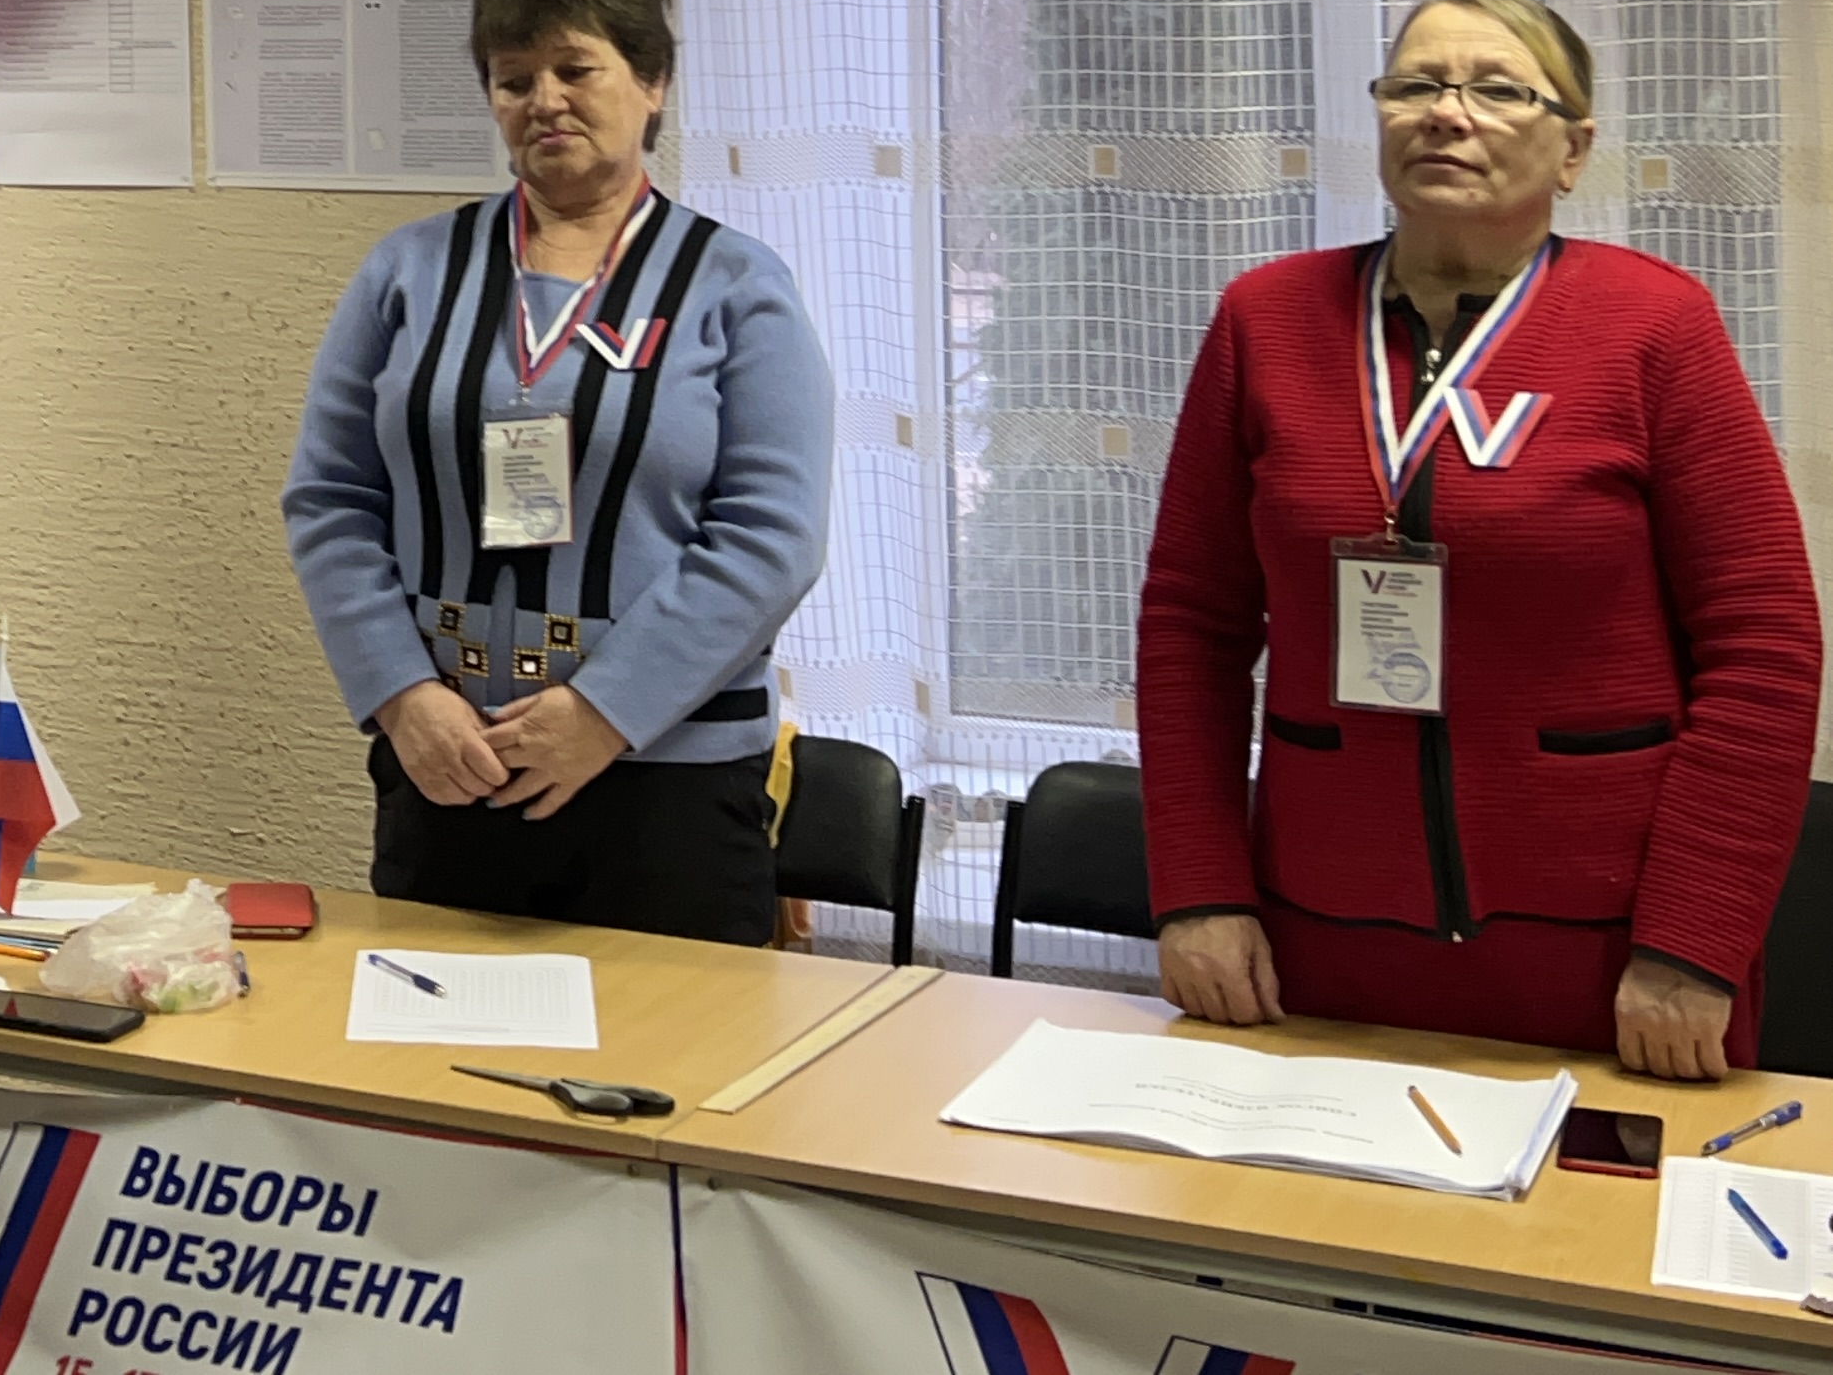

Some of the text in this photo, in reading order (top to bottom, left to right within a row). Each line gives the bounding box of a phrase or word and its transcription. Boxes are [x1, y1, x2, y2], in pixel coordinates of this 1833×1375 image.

[119, 1146, 379, 1237] ВЫБОРЫ
[92, 1218, 464, 1334] ПРЕЗИДЕНТА
[68, 1288, 302, 1375] РОССИИ
